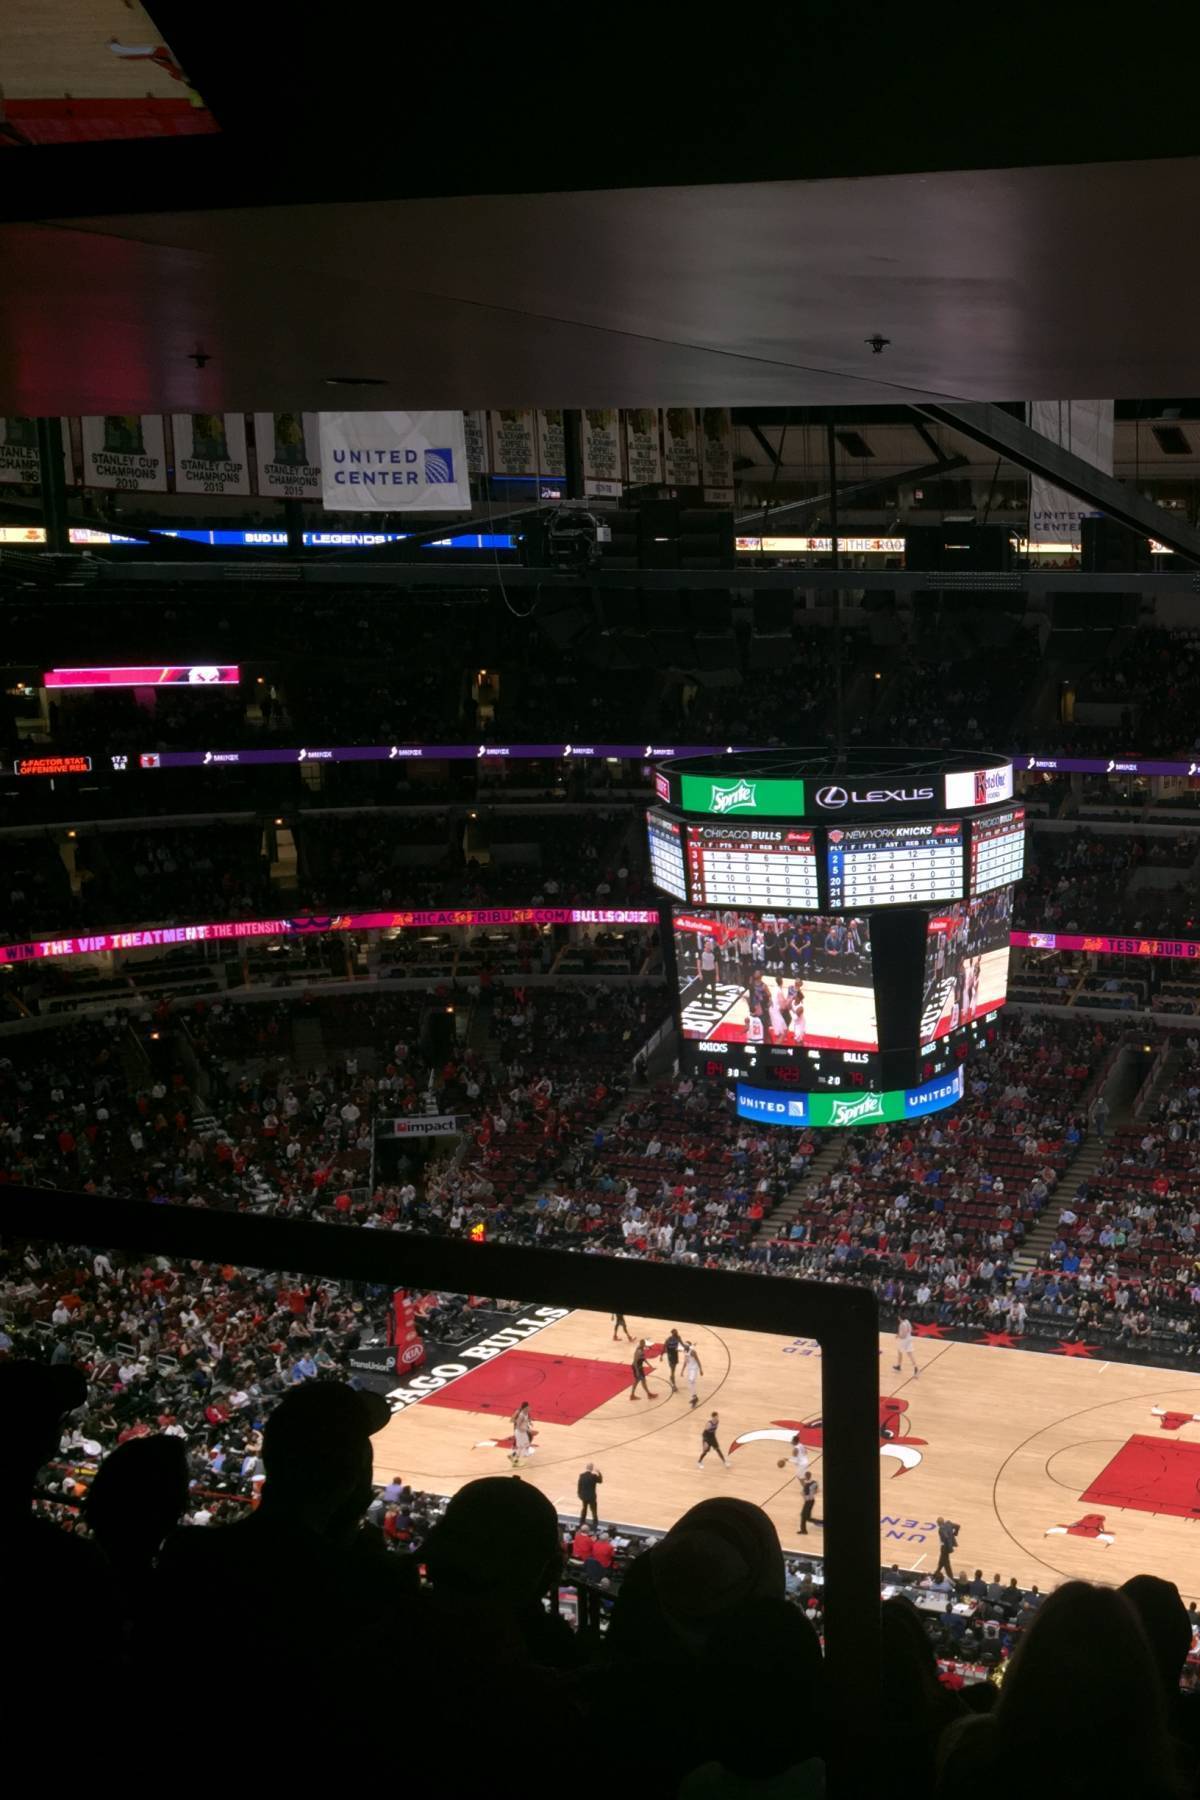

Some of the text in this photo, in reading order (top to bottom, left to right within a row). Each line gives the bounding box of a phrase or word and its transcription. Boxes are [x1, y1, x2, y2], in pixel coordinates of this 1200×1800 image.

[0, 446, 40, 459] TANLEY
[333, 449, 418, 464] UNITED
[0, 458, 40, 470] CHAMPI
[92, 452, 159, 468] STANLEY CUP
[181, 460, 243, 473] STANLEY CUP
[96, 465, 157, 479] CHAMPIONS
[264, 464, 321, 476] STANLEY CUP
[115, 478, 139, 489] 2010
[186, 471, 240, 483] CHAMPIONS
[269, 475, 318, 486] CHAMPIONS
[335, 471, 419, 485] CENTER
[204, 482, 224, 492] 2013
[284, 486, 304, 496] 2015
[1033, 511, 1086, 520] UNITED
[245, 533, 270, 543] BUD
[312, 533, 384, 545] LEGENDS
[20, 757, 85, 767] 4-FACTOR STAT
[19, 765, 69, 774] OFFENSIVE
[713, 784, 751, 811] Sprite
[851, 787, 934, 803] LEXUS
[704, 829, 750, 839] CHICAGO
[751, 831, 782, 840] BULLS
[845, 831, 868, 840] NEW
[869, 829, 895, 838] YORK
[896, 827, 932, 837] KNICKS
[832, 855, 838, 863] 2
[832, 866, 838, 874] 5
[830, 888, 841, 896] 21
[212, 924, 233, 937] THE
[6, 945, 35, 959] WIN
[40, 940, 74, 956] THE
[78, 936, 106, 951] VIP
[750, 1057, 757, 1067] 2
[843, 1052, 869, 1064] BULLS
[910, 1087, 953, 1106] UNITED
[739, 1095, 786, 1113] UNITED
[836, 1096, 879, 1126] Sprite
[407, 1120, 454, 1133] impact
[459, 1306, 570, 1361] BULLS
[405, 1347, 420, 1362] KIA
[350, 1357, 390, 1371] TransUnion
